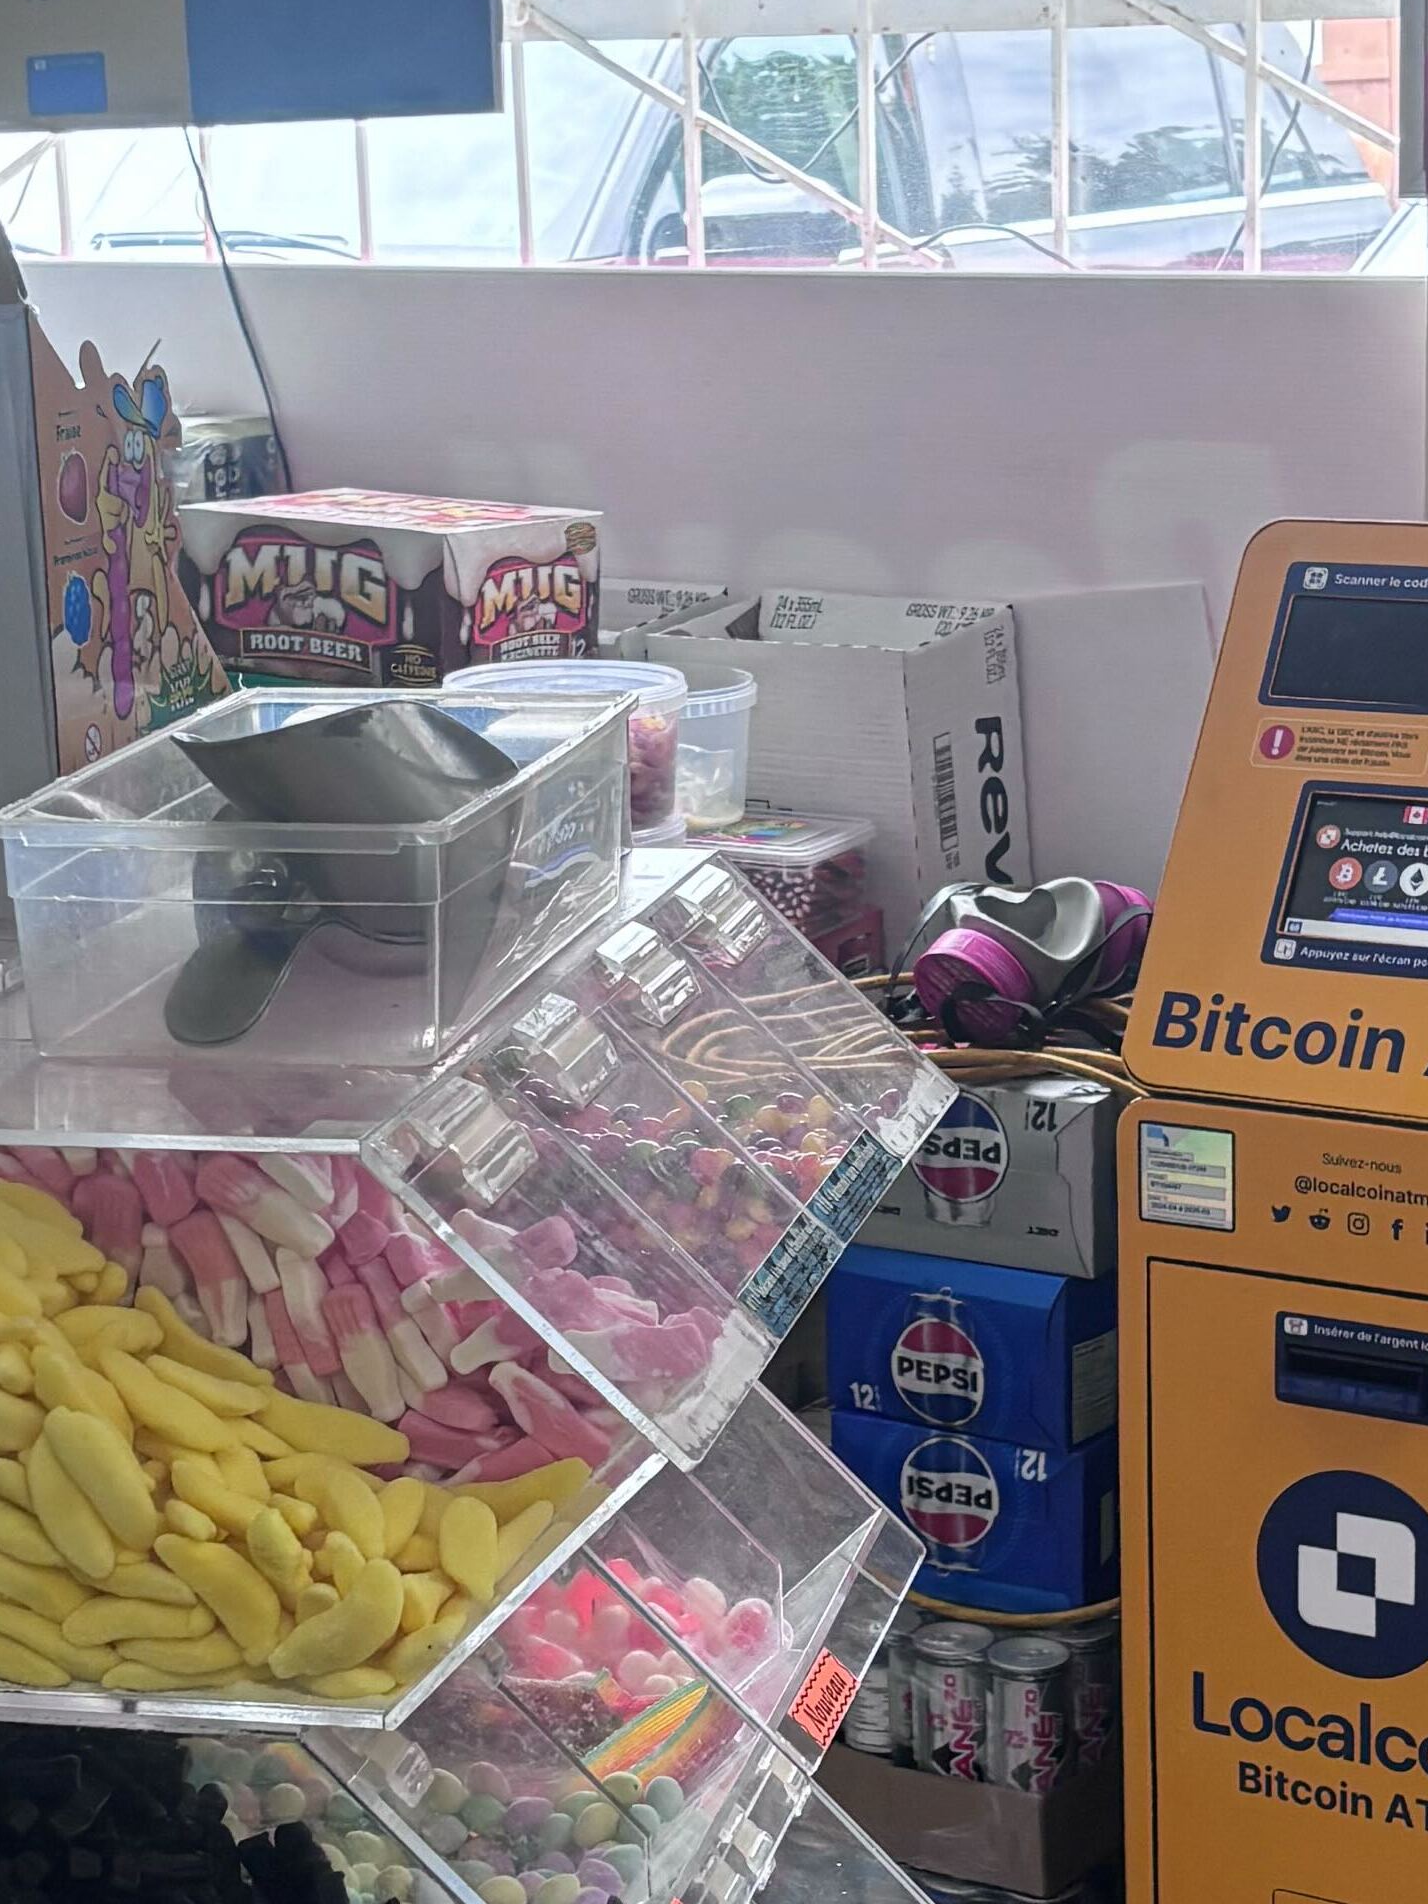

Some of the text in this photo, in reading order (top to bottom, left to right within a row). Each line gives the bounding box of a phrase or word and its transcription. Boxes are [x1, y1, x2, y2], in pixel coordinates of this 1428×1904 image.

[224, 544, 389, 627] MUG
[478, 563, 585, 630] MUG
[1335, 573, 1388, 588] Scanner
[1390, 575, 1401, 588] le
[249, 633, 364, 663] ROOT BEER
[1340, 838, 1394, 857] Achetez
[1396, 844, 1421, 858] des
[1153, 990, 1407, 1074] Bitcoin
[1029, 1100, 1059, 1133] 12
[1321, 1151, 1403, 1175] Suivez-nous
[1313, 1323, 1355, 1341] Insérer
[1356, 1329, 1373, 1342] de
[1373, 1332, 1419, 1351] l'argent
[895, 1355, 983, 1395] PEPSI
[906, 1468, 994, 1512] PEPSI
[1238, 1760, 1374, 1821] Bitcoin
